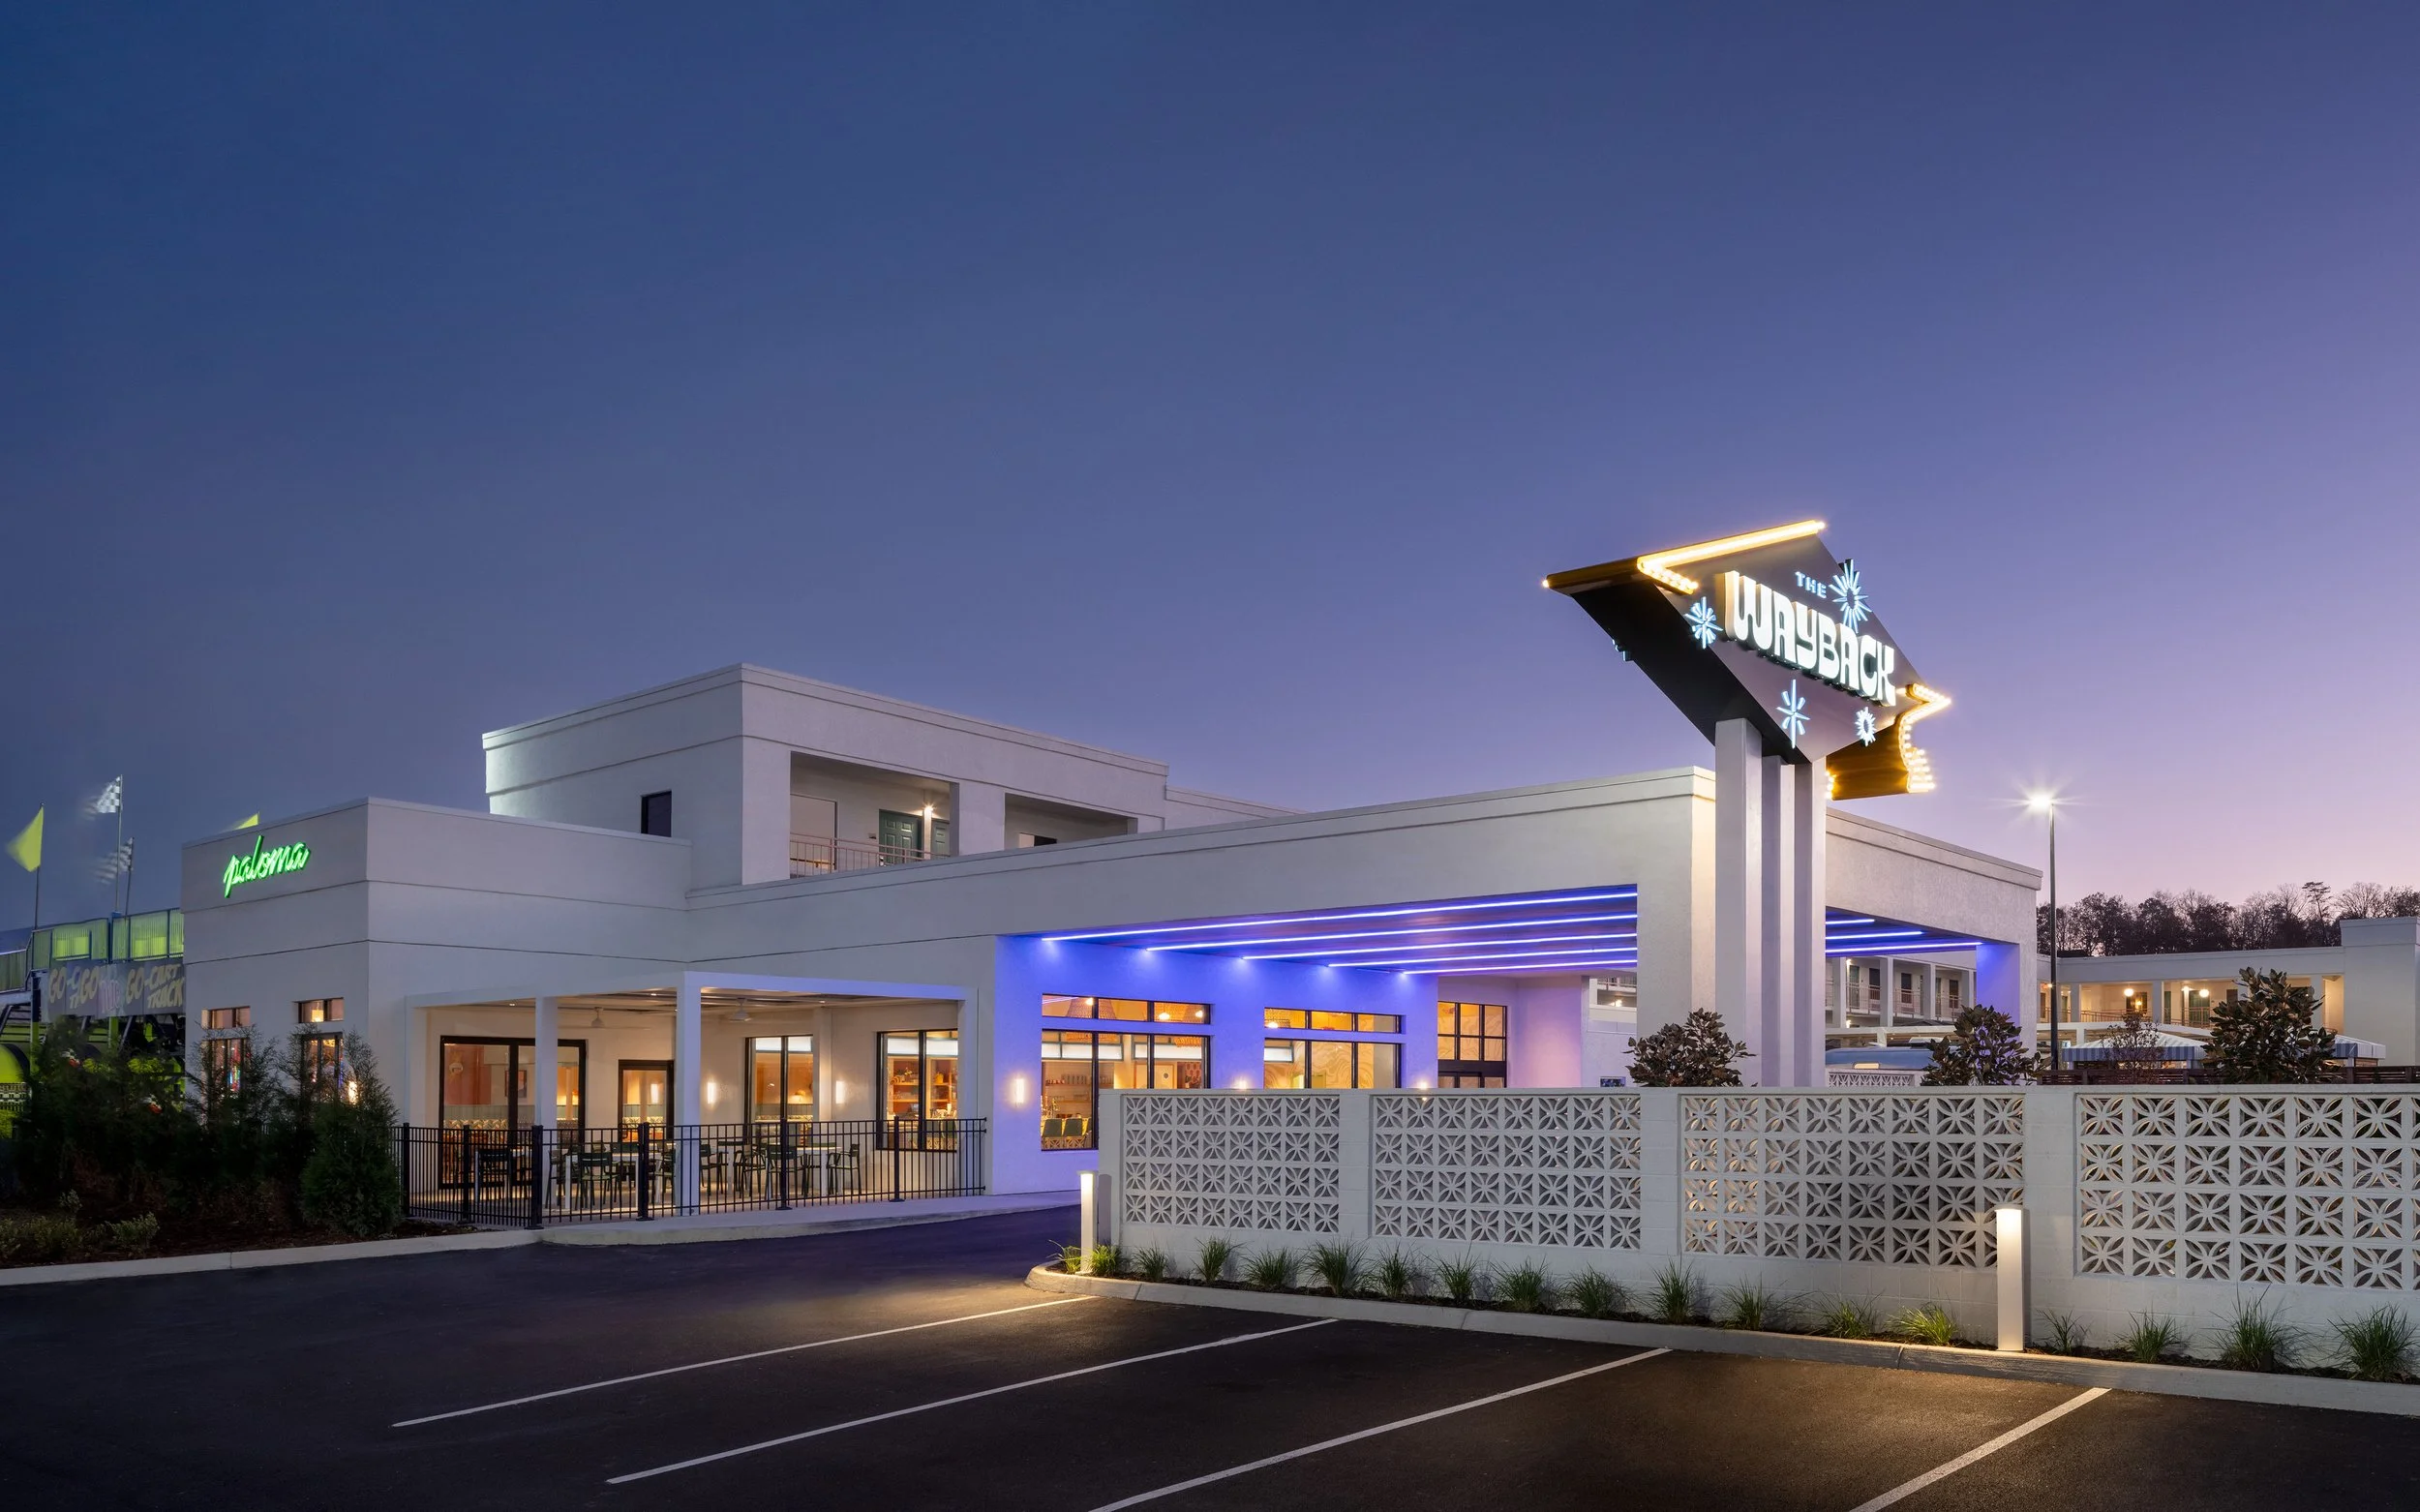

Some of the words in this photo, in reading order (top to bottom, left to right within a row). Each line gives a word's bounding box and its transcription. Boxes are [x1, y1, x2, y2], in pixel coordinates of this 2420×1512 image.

[1795, 571, 1827, 597] THE
[1724, 570, 1896, 706] WAYBACK
[223, 834, 311, 898] paloma
[147, 976, 185, 1009] TRACK
